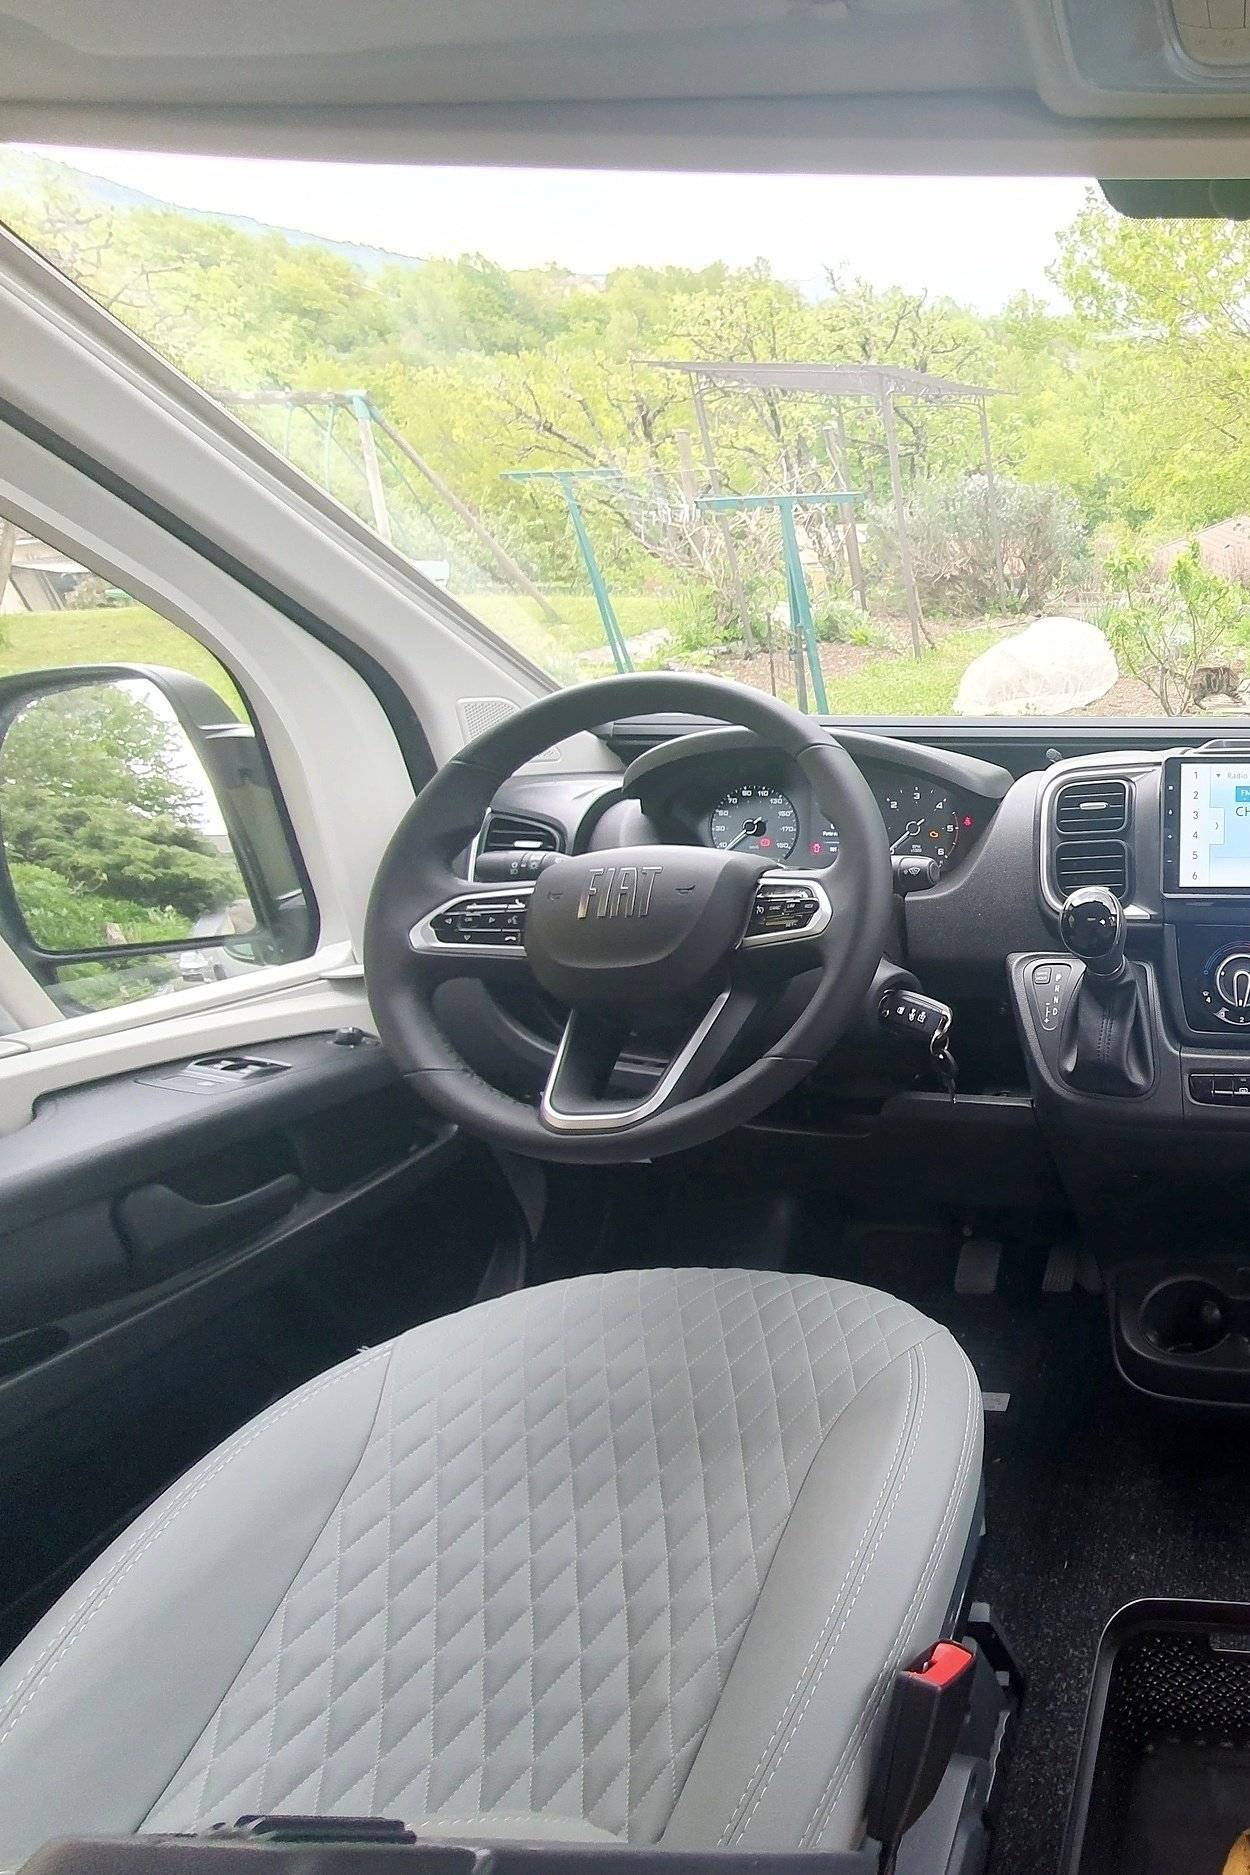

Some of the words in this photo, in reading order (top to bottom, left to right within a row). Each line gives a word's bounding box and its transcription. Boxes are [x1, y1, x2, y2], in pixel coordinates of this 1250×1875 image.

[913, 792, 920, 800] 3
[1193, 791, 1199, 800] 2
[890, 801, 898, 809] 2
[936, 801, 943, 809] 4
[1193, 810, 1199, 820] 3
[946, 824, 954, 832] 5
[1192, 831, 1198, 839] 4
[937, 848, 945, 856] 6
[1192, 851, 1198, 860] 5
[1192, 871, 1198, 880] 6
[577, 866, 662, 919] FIAT
[1056, 973, 1062, 981] P
